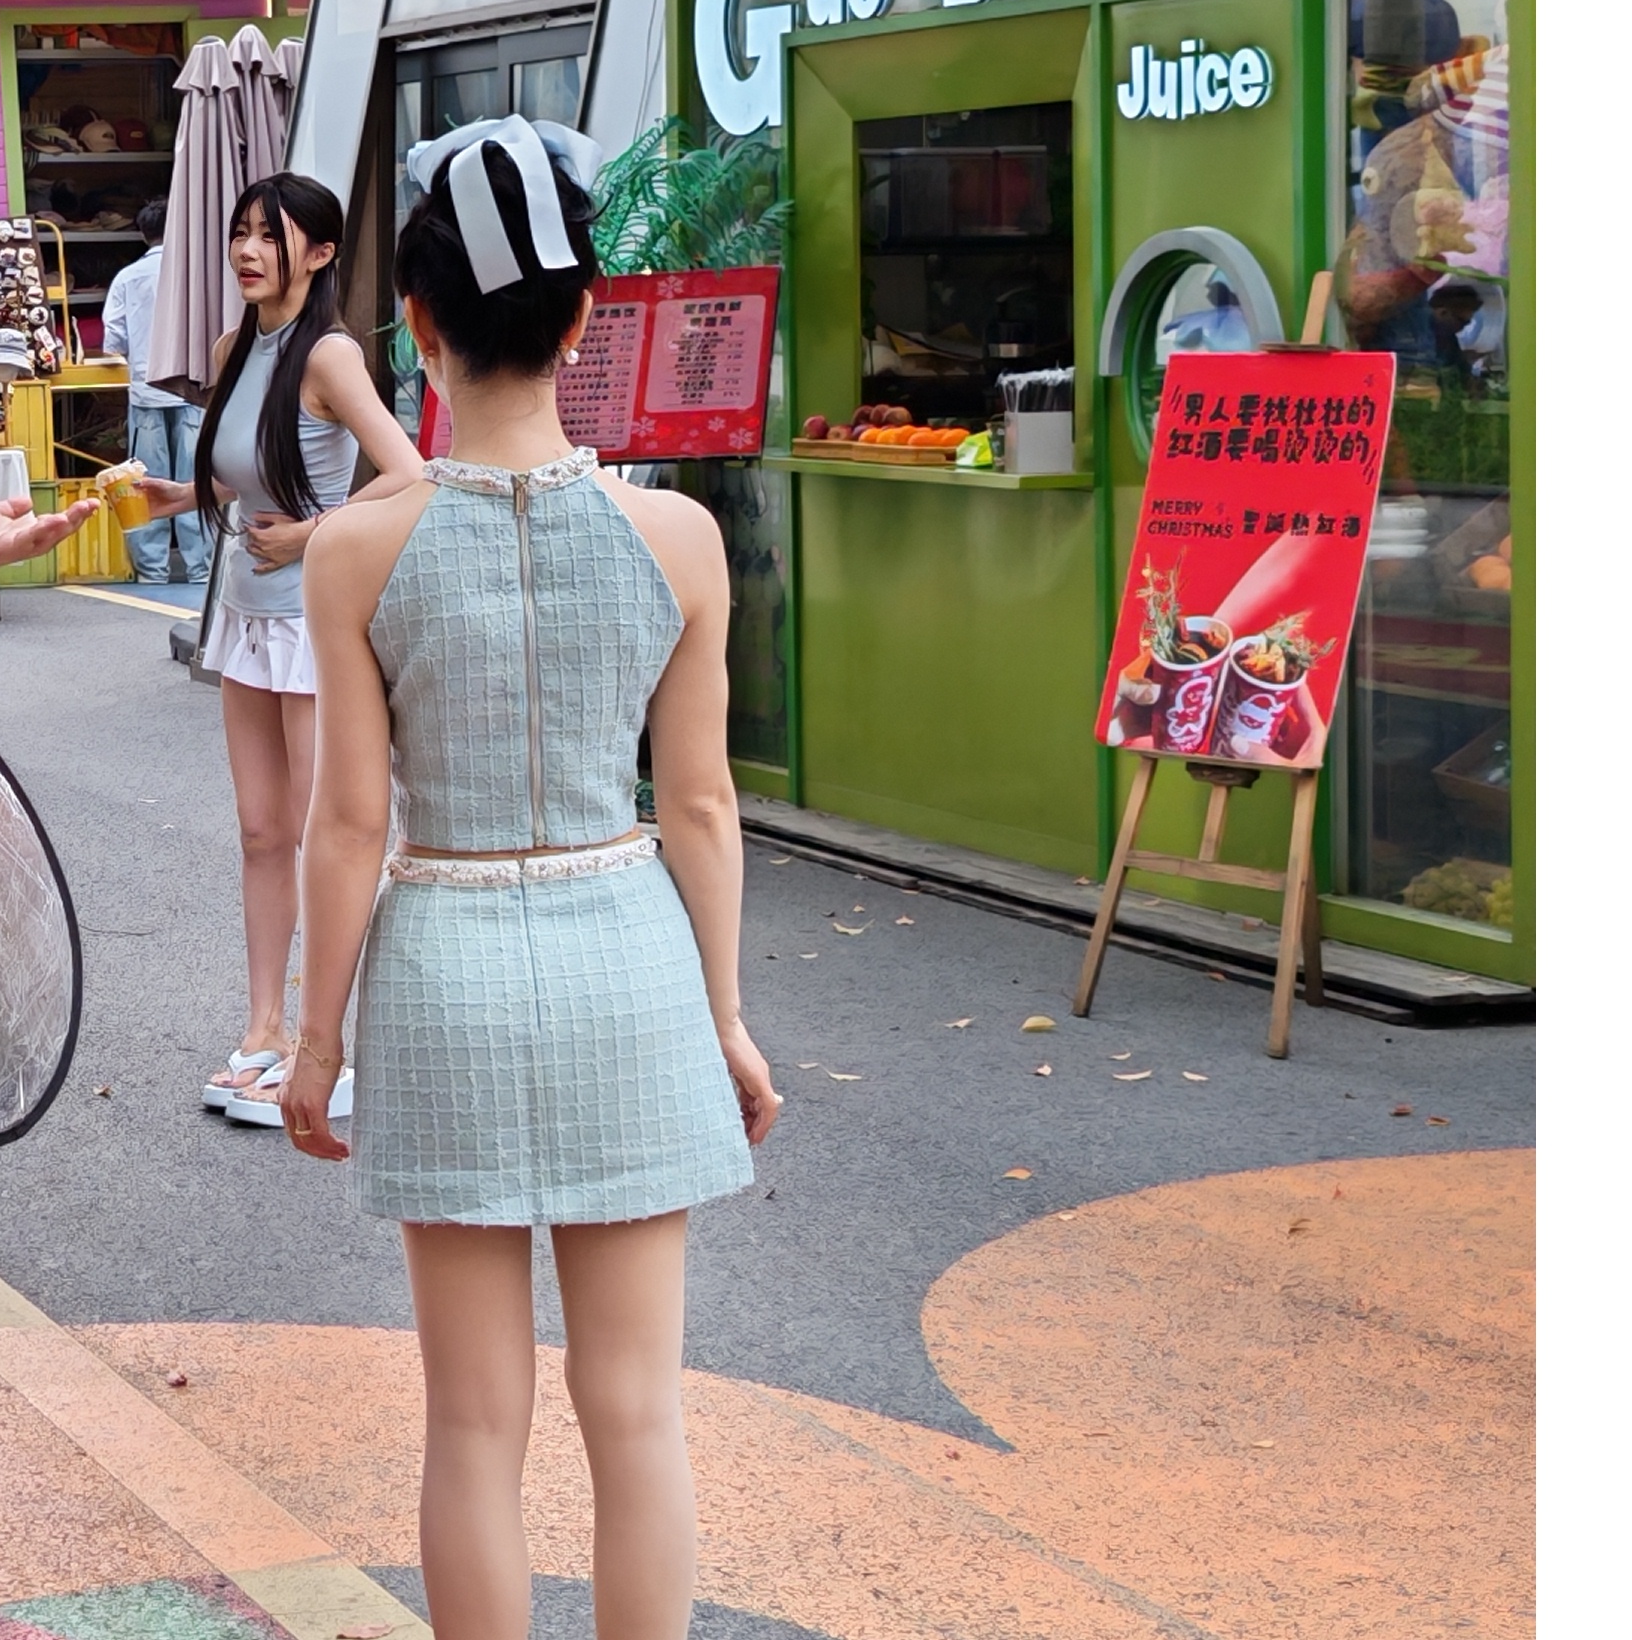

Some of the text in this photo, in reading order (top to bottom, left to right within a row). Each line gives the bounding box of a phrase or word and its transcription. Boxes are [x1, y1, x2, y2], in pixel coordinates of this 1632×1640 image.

[1117, 38, 1272, 120] Juice
[1151, 500, 1203, 515] MERRY
[1147, 520, 1233, 539] CHRISTMAS
